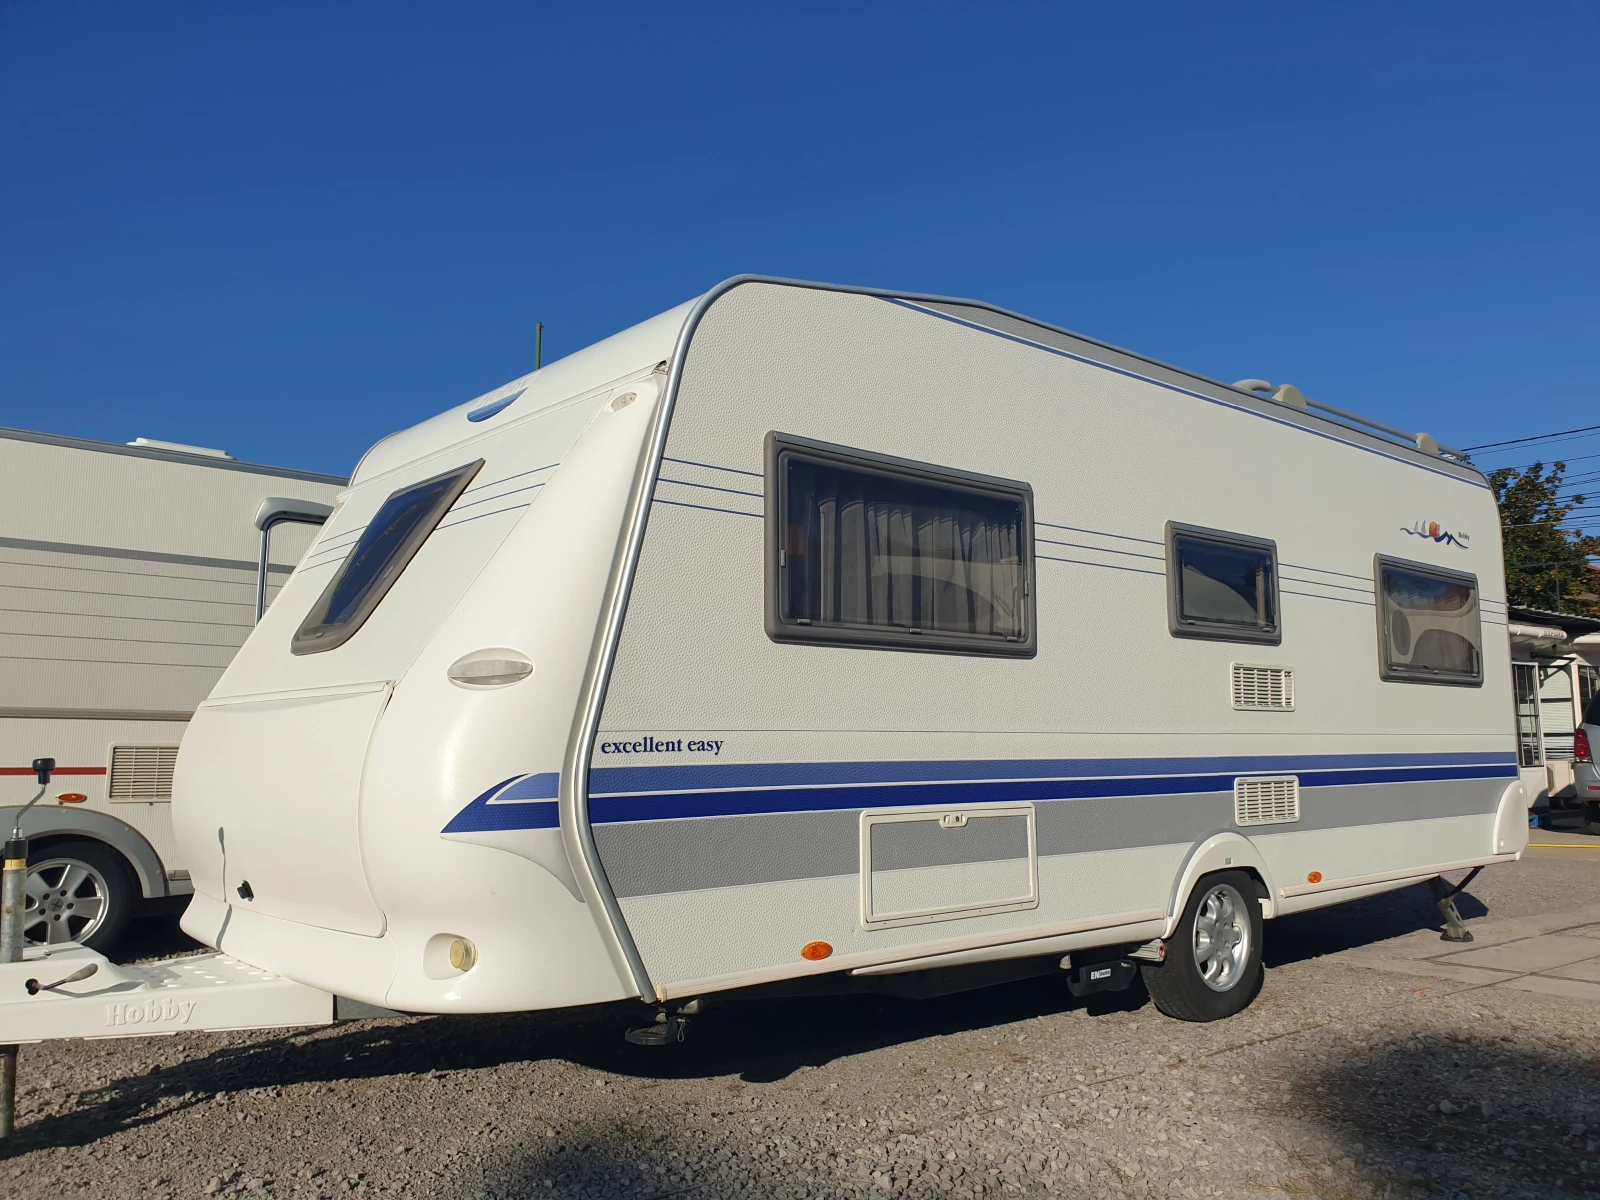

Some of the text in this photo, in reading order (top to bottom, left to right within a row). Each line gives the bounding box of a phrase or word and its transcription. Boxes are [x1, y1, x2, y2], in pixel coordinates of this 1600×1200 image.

[601, 736, 724, 756] excellent easy
[105, 997, 197, 1028] Hobby
